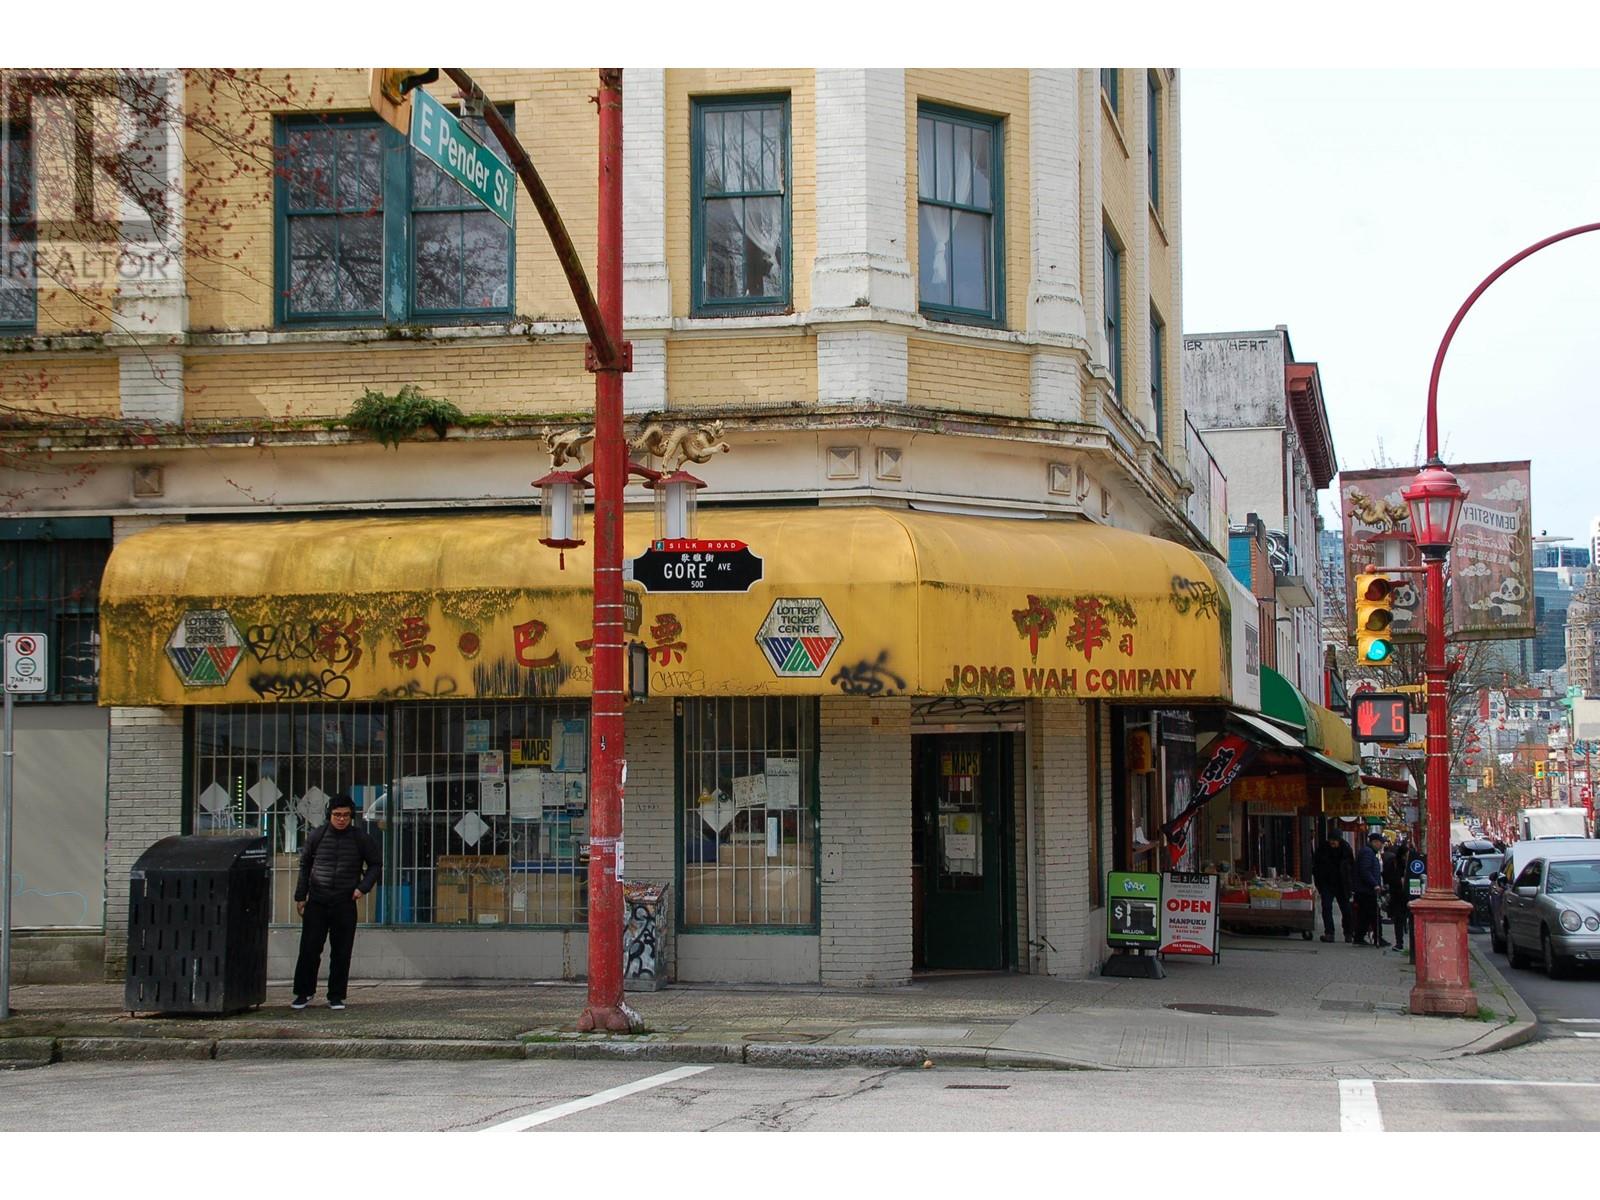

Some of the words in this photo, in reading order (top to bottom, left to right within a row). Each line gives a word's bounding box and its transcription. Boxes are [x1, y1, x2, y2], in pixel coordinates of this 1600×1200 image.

[421, 102, 433, 146] E
[438, 117, 490, 193] Pender
[493, 168, 509, 212] St
[663, 562, 708, 579] GORE
[717, 562, 732, 571] AVE
[690, 580, 704, 588] 500
[777, 605, 821, 616] LOTTERY
[781, 615, 817, 625] TICKET
[778, 624, 820, 634] CENTRE
[945, 664, 1016, 690] JONG
[1022, 668, 1077, 691] WAH
[1085, 668, 1197, 692] COMPANY
[1392, 703, 1404, 733] 6
[521, 740, 550, 761] MAPS
[952, 751, 978, 775] MAPS
[1166, 898, 1211, 913] OPEN
[1169, 917, 1207, 926] MANPUKU
